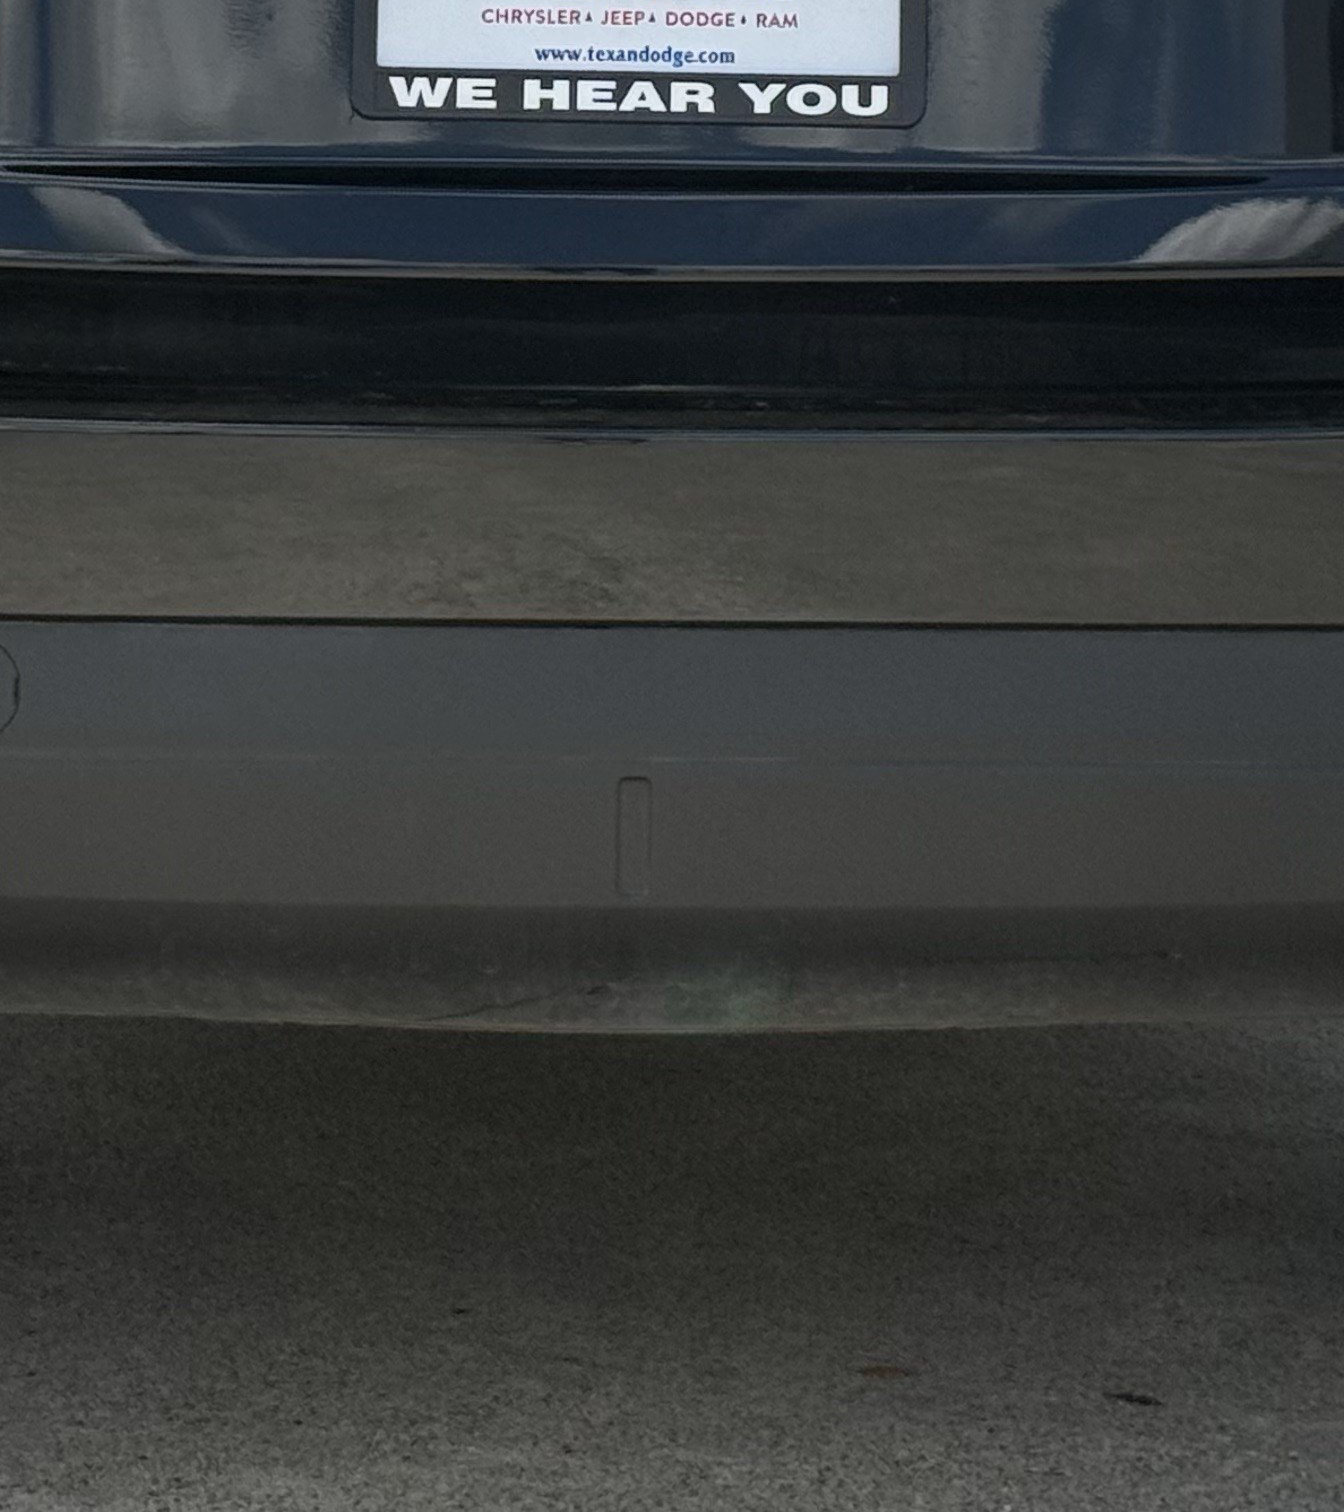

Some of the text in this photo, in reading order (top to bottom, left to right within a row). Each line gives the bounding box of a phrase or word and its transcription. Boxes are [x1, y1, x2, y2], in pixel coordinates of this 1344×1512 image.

[481, 8, 799, 29] CHRYSLER JEEP DODGE RAM
[534, 45, 736, 68] www.texandodge.com
[389, 76, 889, 116] WE HEAR YOU
